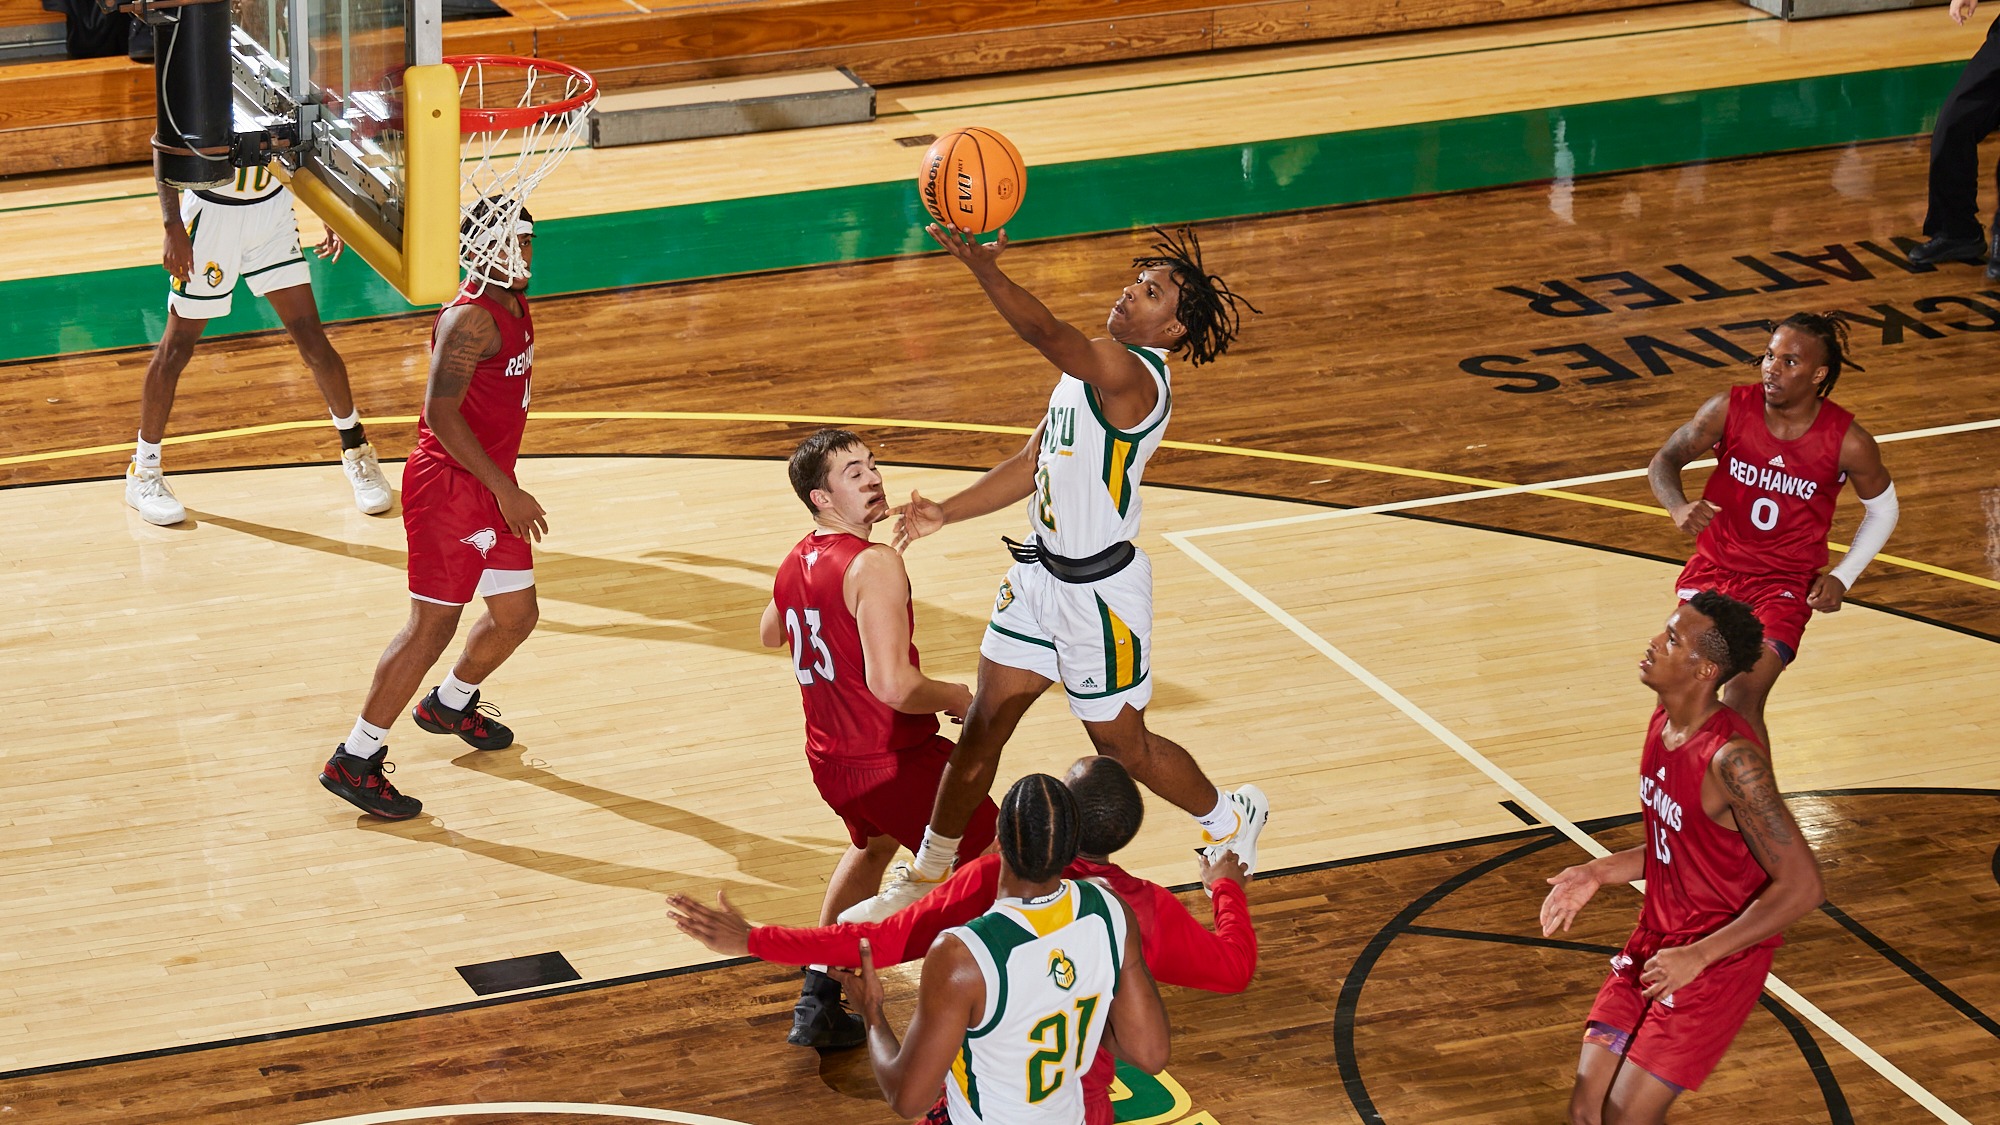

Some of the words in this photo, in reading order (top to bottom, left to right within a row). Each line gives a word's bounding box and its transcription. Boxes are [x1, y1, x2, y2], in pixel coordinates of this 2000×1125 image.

[924, 154, 946, 222] Wilson
[1730, 456, 1758, 487] RED
[1758, 468, 1818, 500] HAWKS
[1751, 497, 1779, 531] 0
[785, 607, 835, 685] 23
[1025, 993, 1101, 1105] 21
